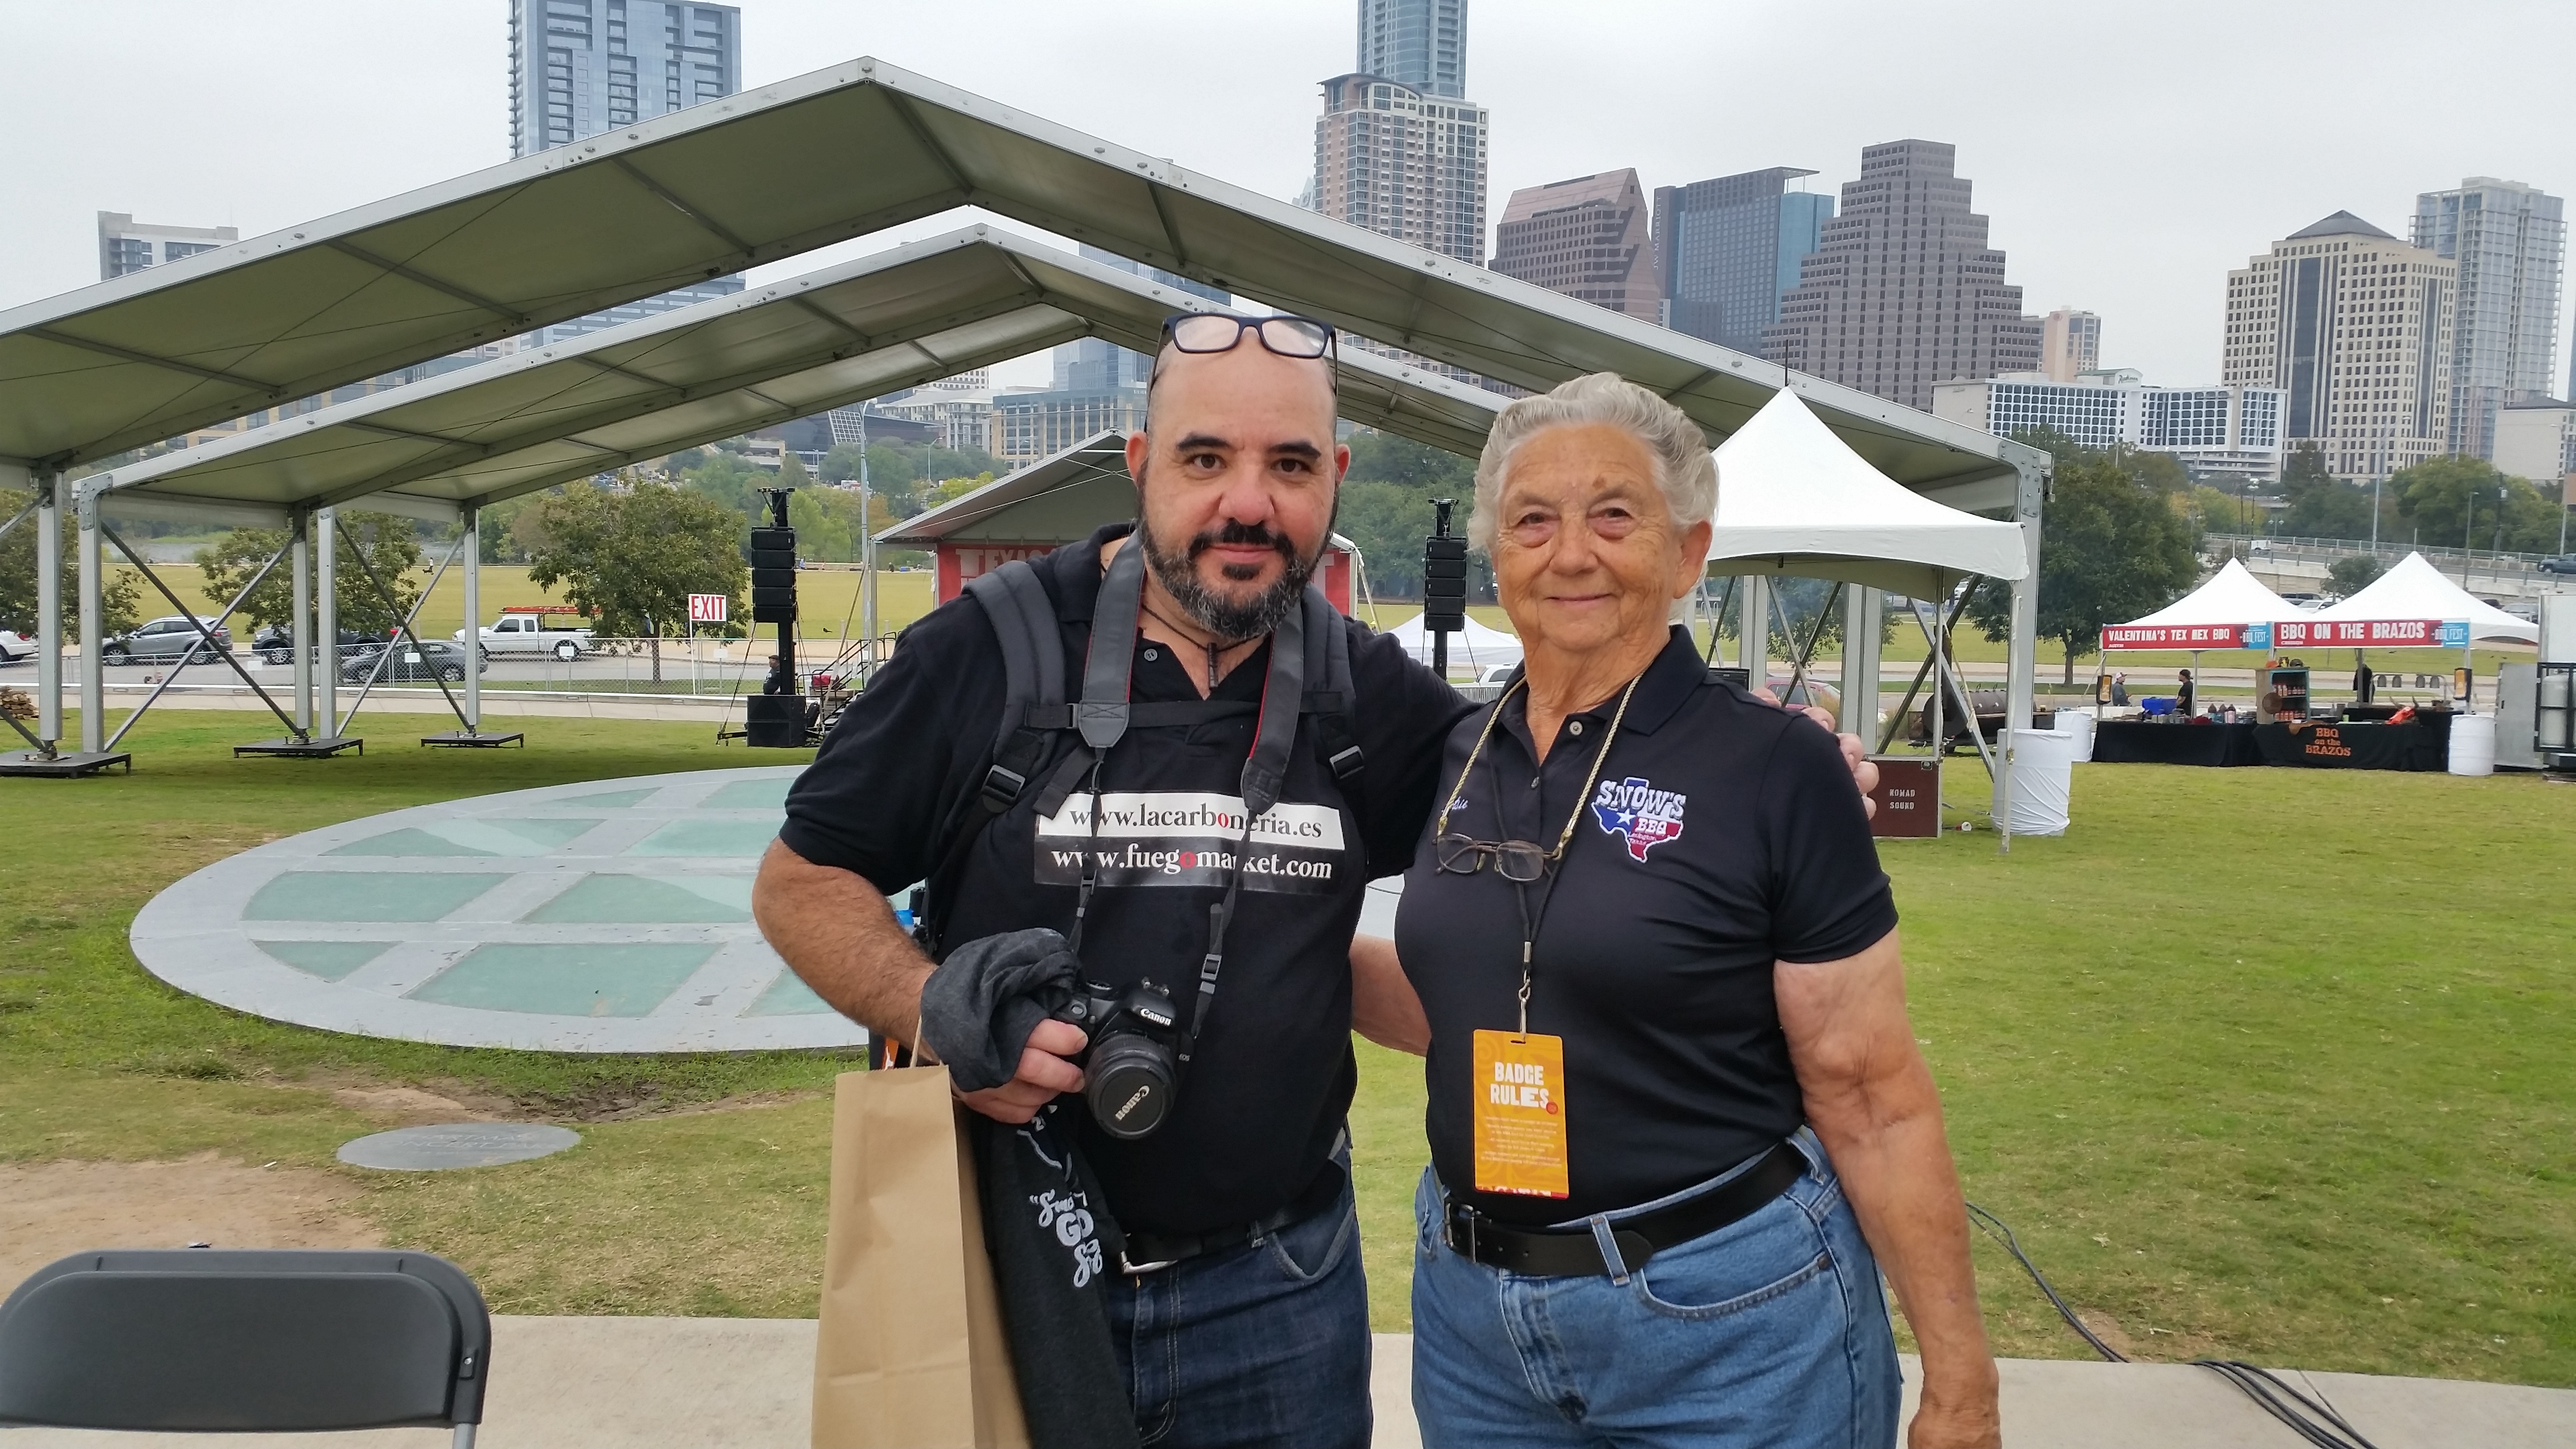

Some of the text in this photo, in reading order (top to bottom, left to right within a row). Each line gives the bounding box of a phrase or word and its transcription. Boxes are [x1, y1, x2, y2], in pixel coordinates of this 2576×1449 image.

[691, 596, 724, 620] EXIT
[2171, 629, 2187, 641] TEX
[2191, 629, 2209, 640] MEX
[2213, 628, 2230, 641] BBQ
[2281, 622, 2425, 639] BBQ ON THE BRAZOS
[2316, 727, 2339, 738] BBQ
[2305, 744, 2351, 757] BRAZOS
[1595, 780, 1687, 820] SNOW'S
[1890, 789, 1916, 797] NOMAD
[1890, 802, 1915, 810] SOUND
[1635, 818, 1667, 836] BBQ
[1140, 1008, 1172, 1026] Canon
[1494, 1062, 1544, 1086] BADGE
[1115, 1085, 1150, 1121] Canon
[1490, 1083, 1549, 1109] RULES
